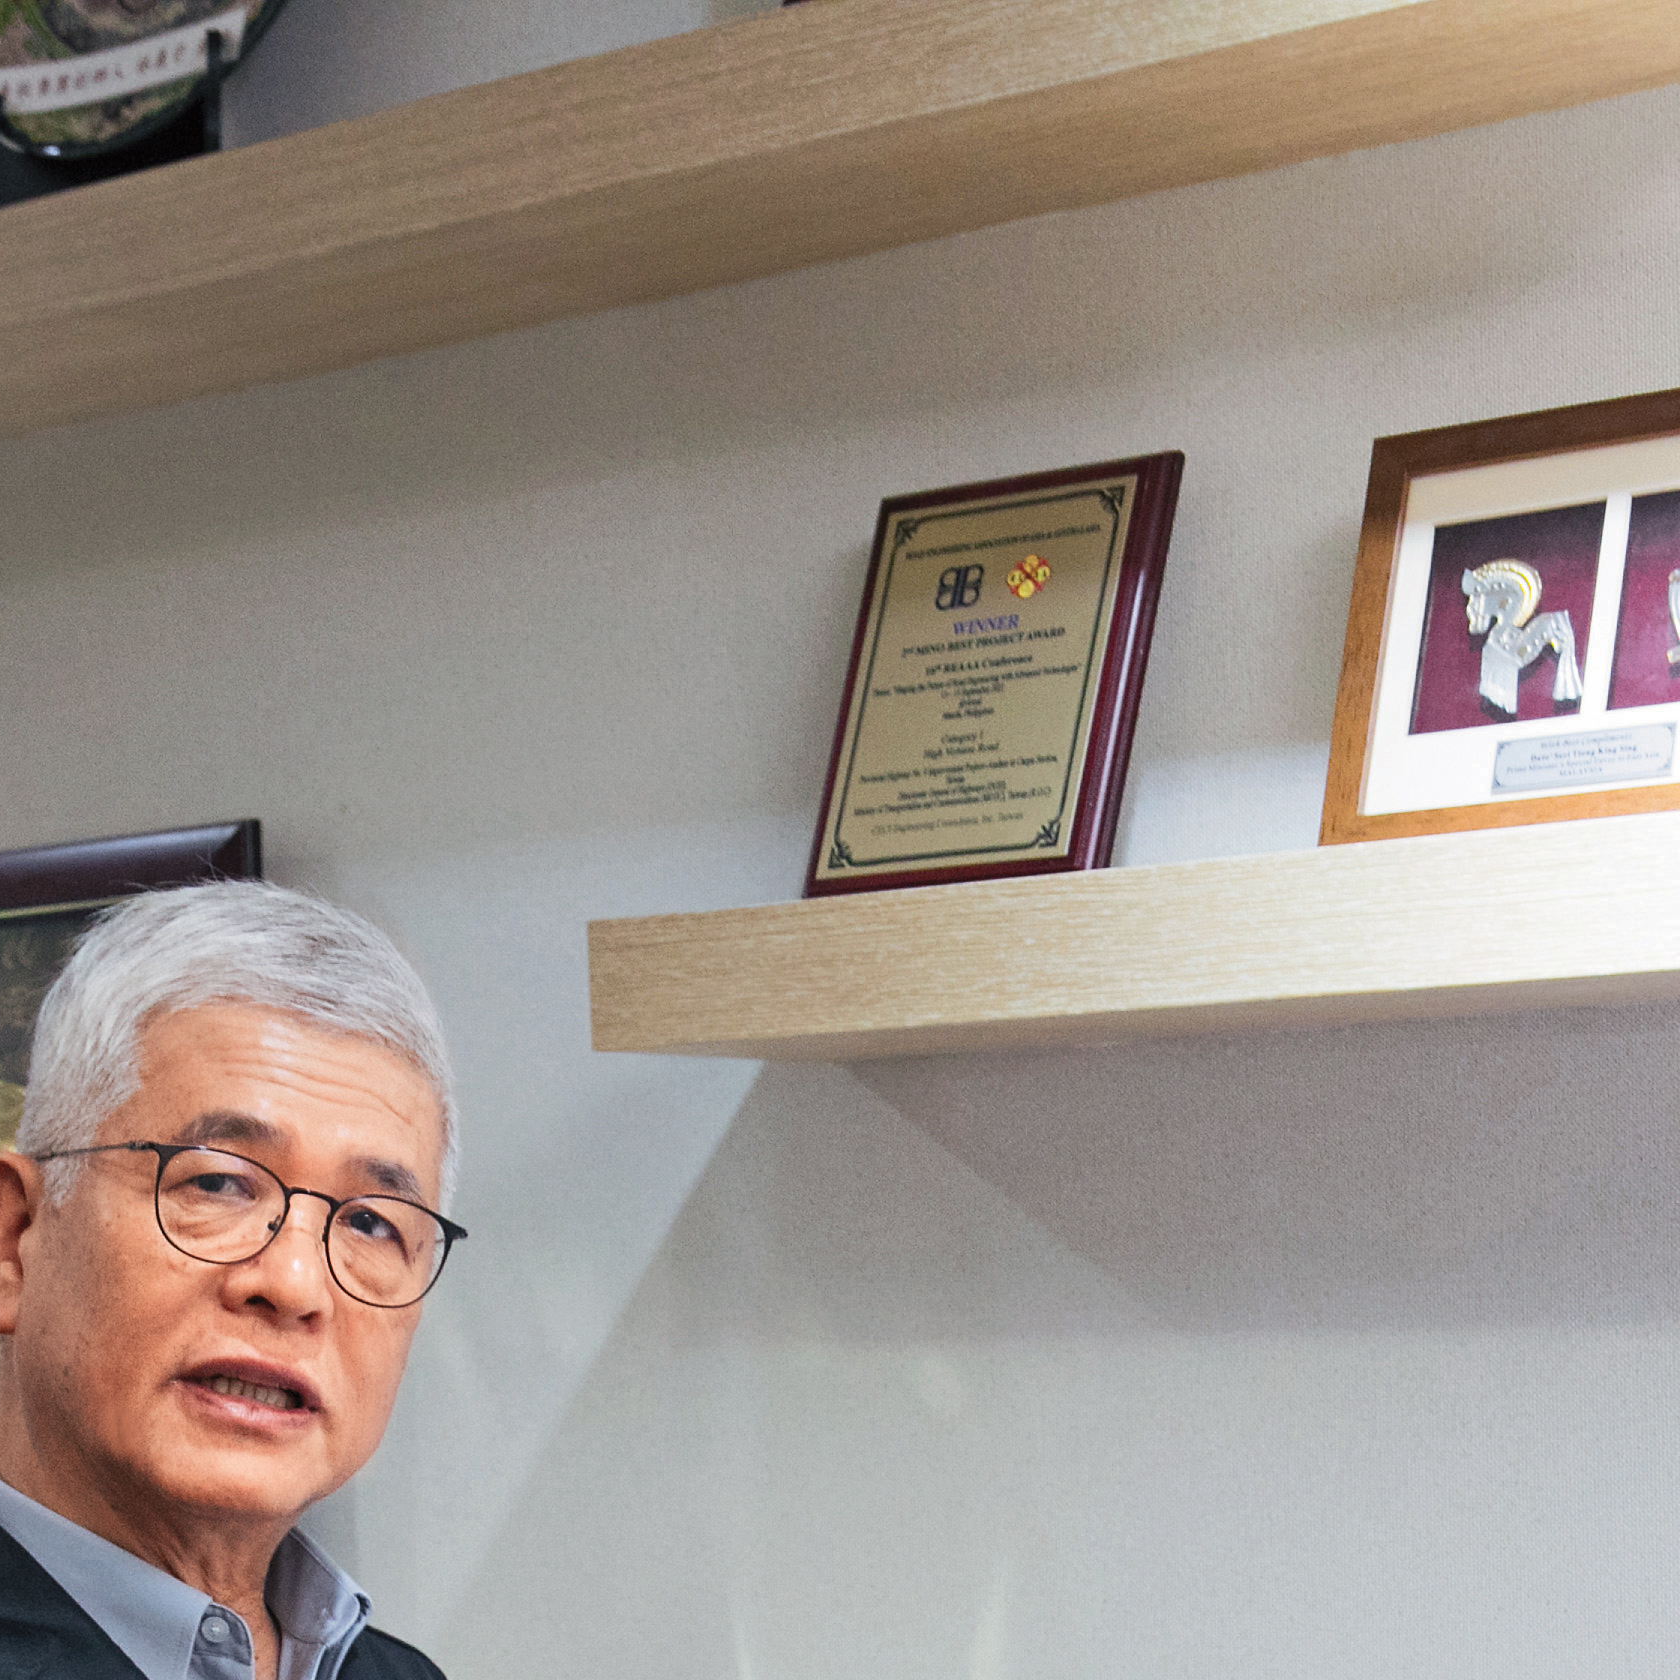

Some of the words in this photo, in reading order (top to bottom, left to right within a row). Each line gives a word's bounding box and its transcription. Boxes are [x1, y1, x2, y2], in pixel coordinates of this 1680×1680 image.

[953, 614, 1020, 635] WINNER
[947, 639, 974, 652] BEST
[975, 631, 1025, 648] PROJECT
[1027, 626, 1066, 641] AWARD
[981, 654, 1033, 668] Conference
